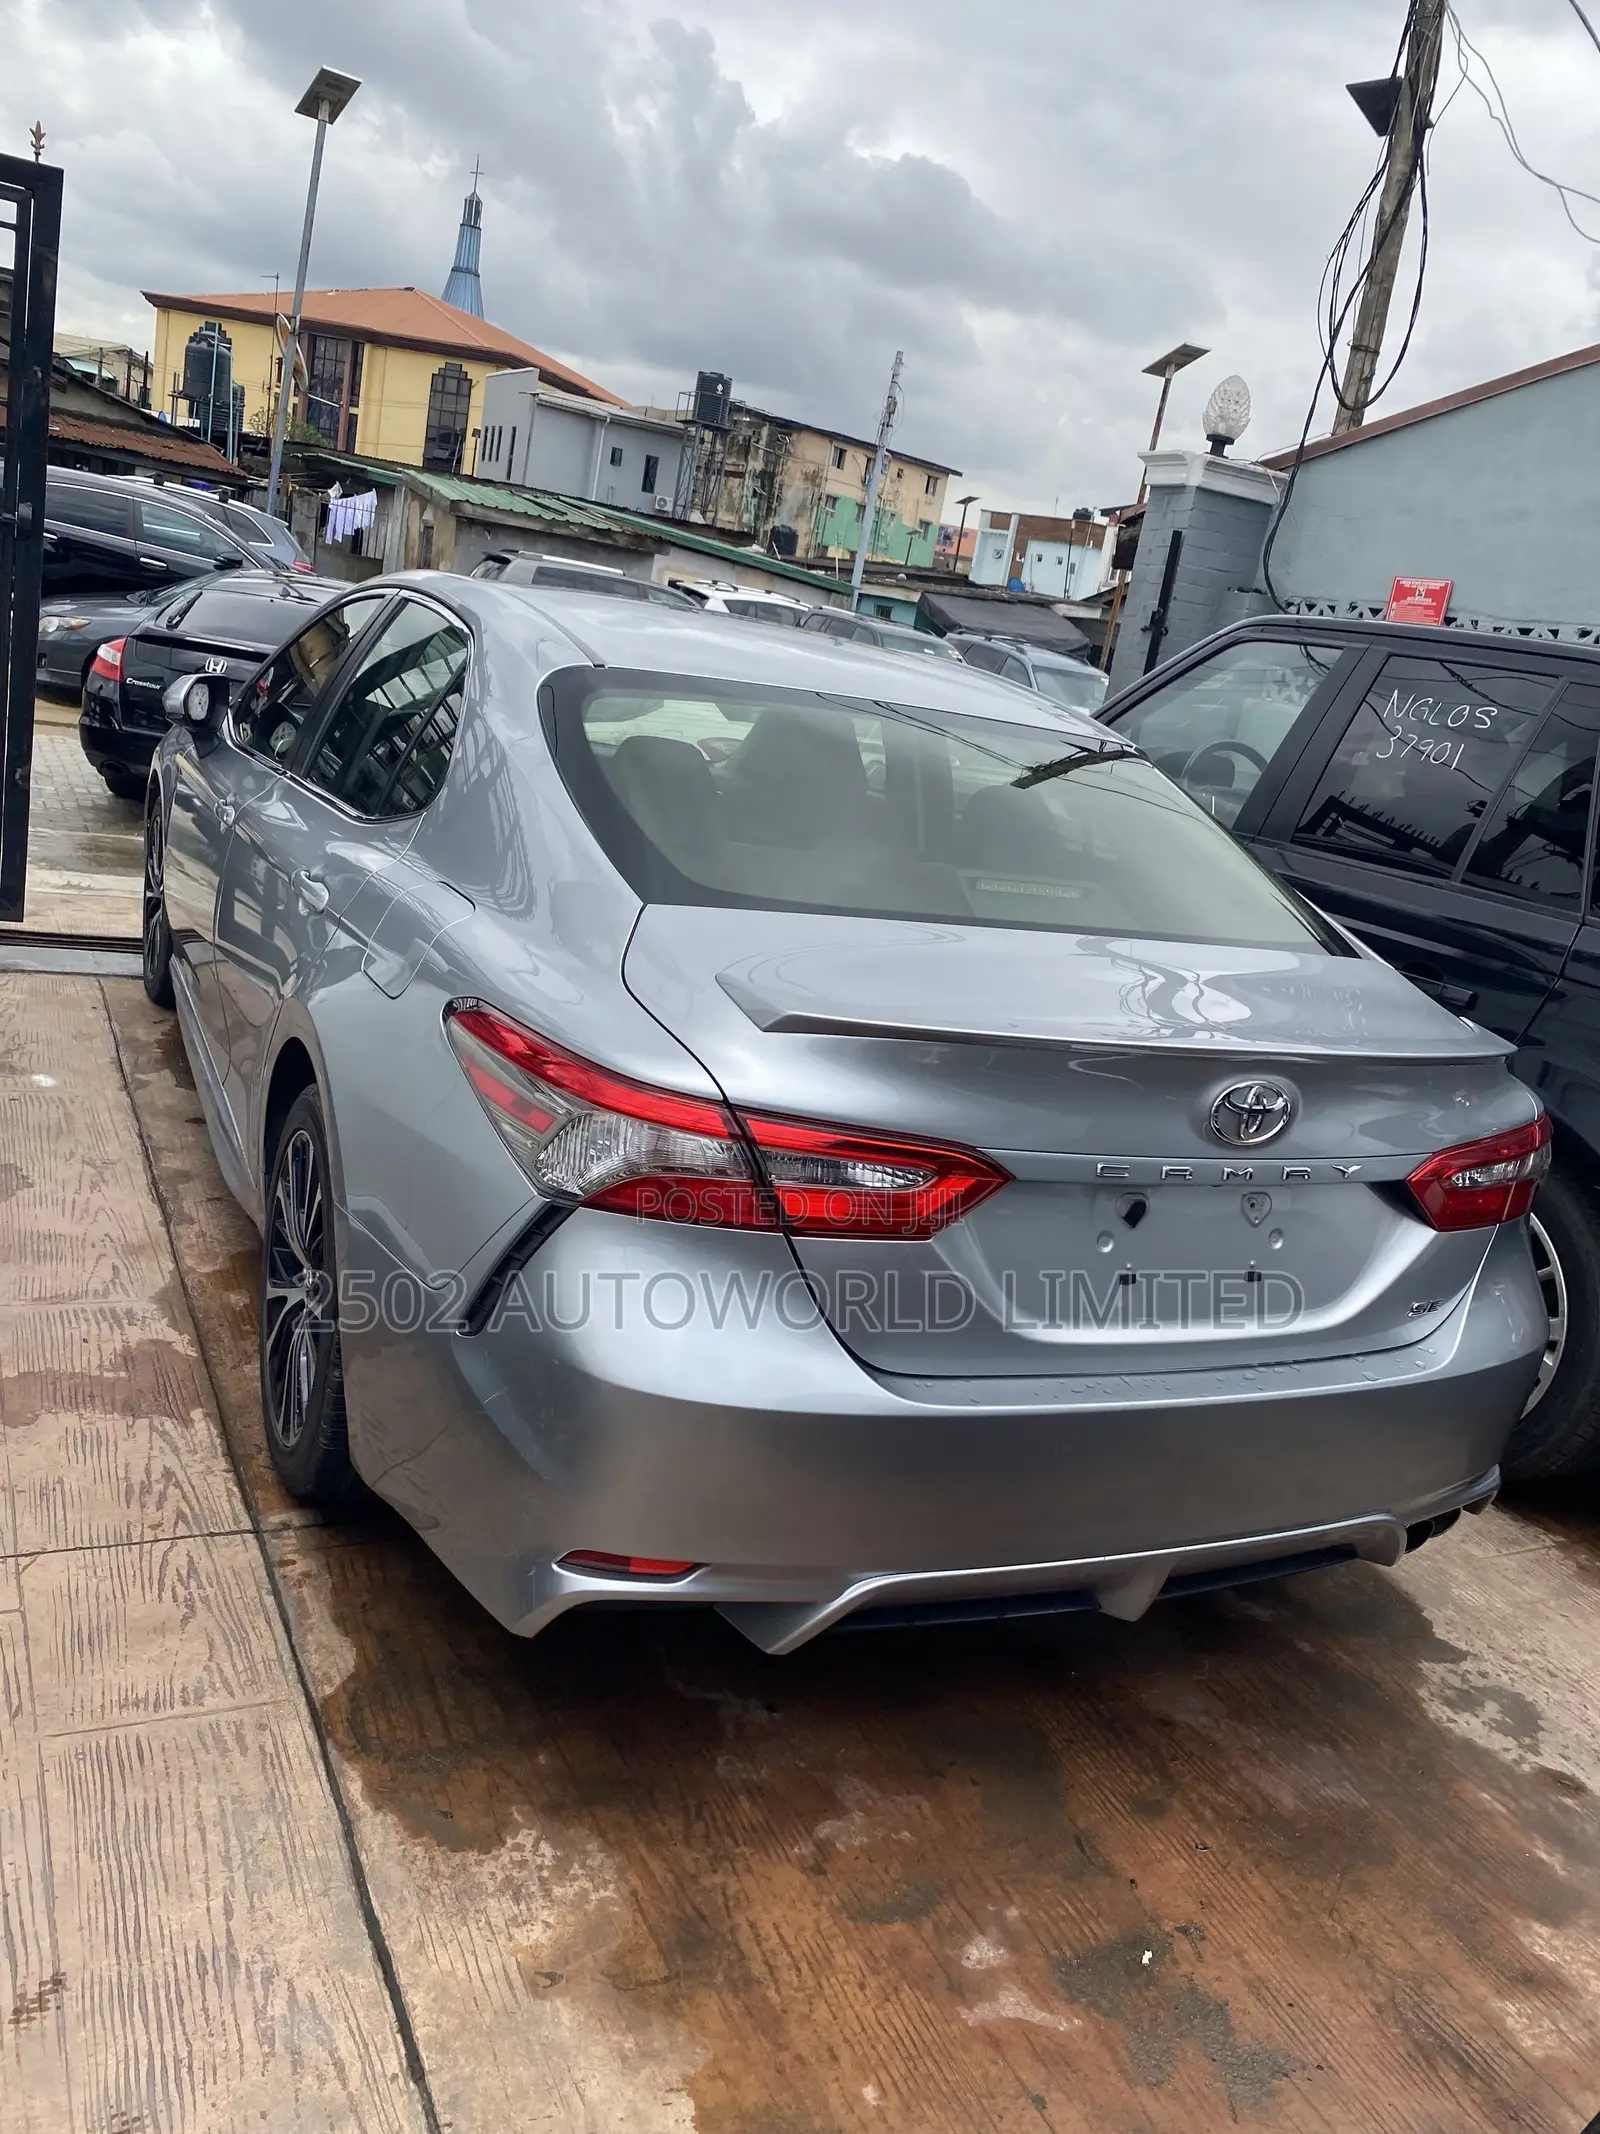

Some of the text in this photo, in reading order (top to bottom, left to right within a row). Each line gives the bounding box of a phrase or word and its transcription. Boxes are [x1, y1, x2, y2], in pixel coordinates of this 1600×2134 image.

[126, 677, 162, 690] Crosstour
[1383, 688, 1498, 729] NGLOS
[1376, 725, 1465, 770] 37901
[1096, 1162, 1364, 1180] CAMRY
[1406, 1299, 1444, 1317] SE
